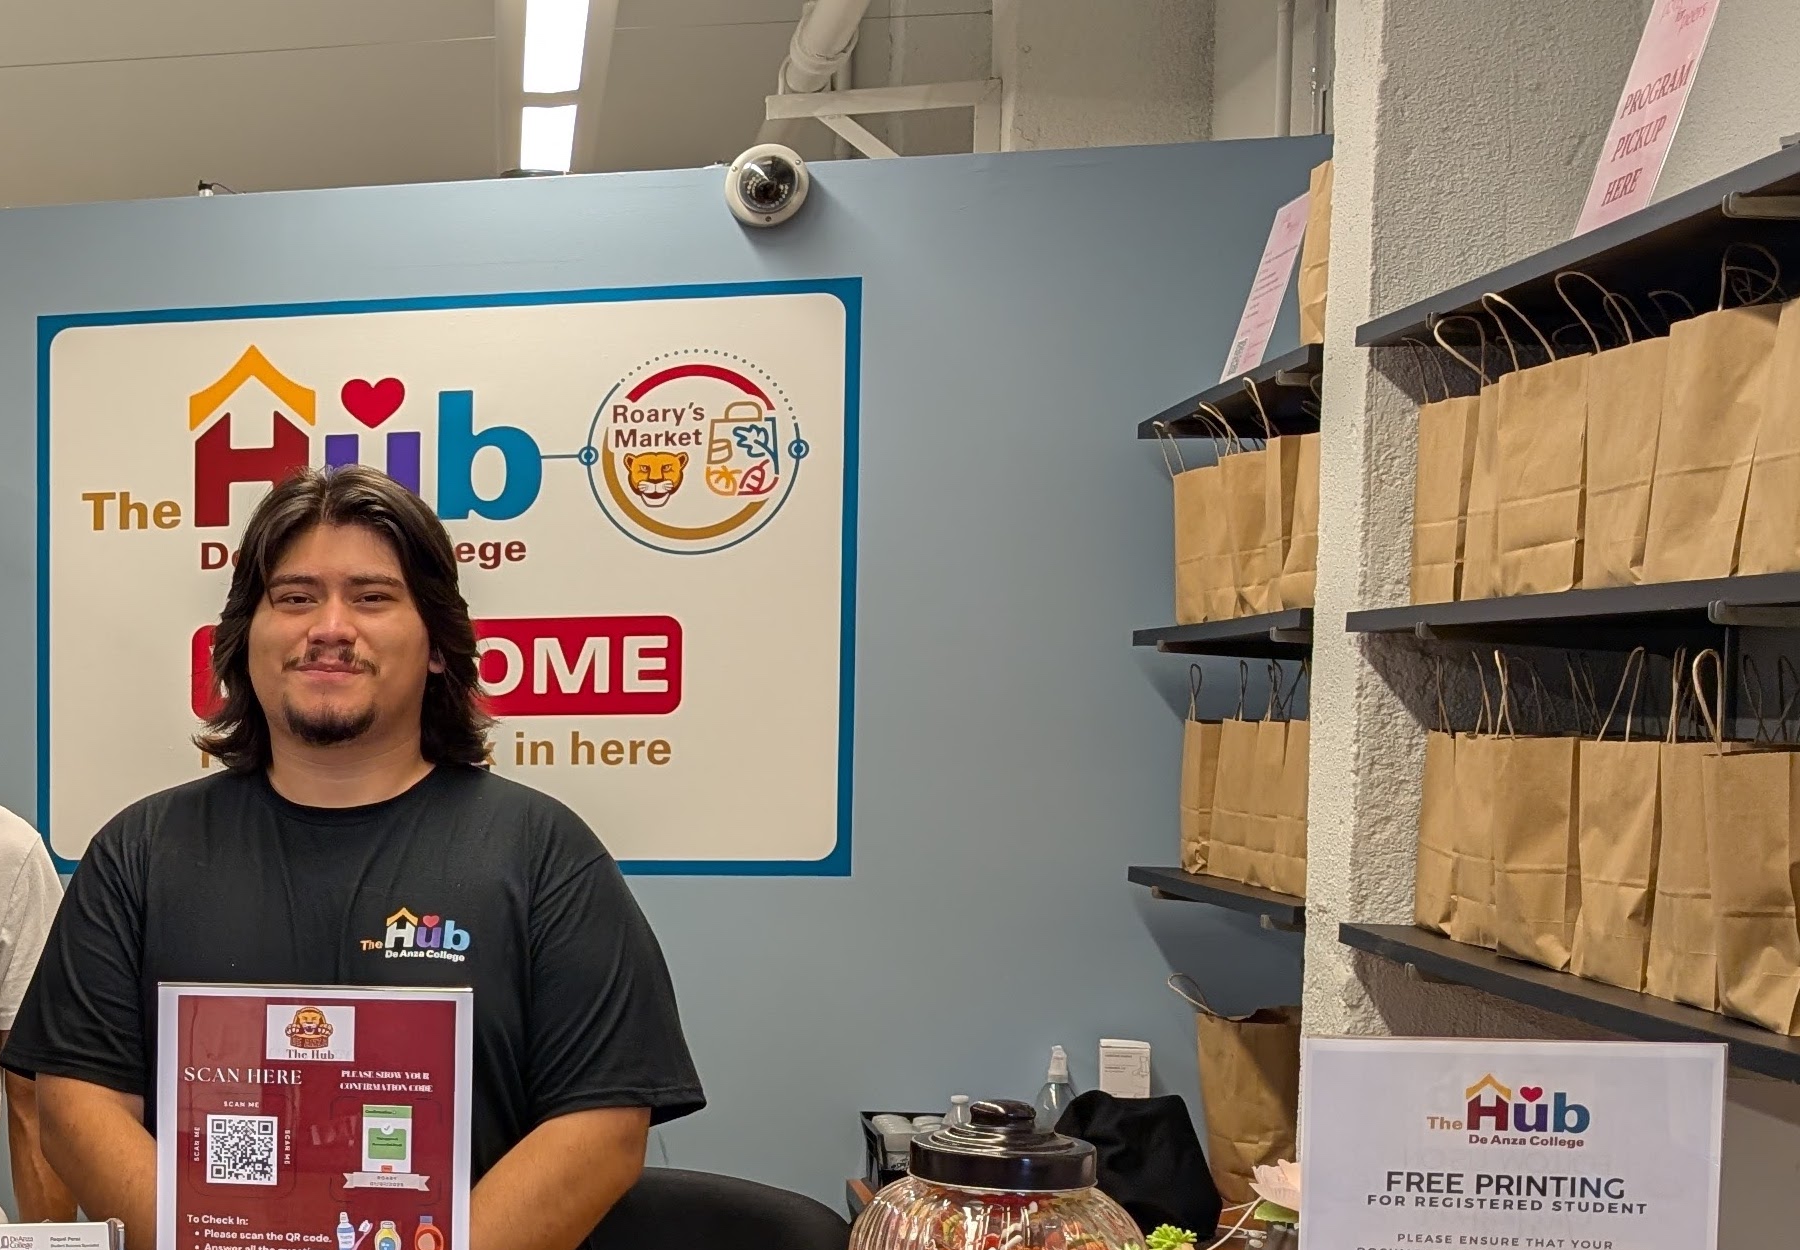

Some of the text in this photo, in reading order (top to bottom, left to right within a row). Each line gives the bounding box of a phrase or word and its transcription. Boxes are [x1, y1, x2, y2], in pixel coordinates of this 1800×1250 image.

[1620, 59, 1695, 119] PROGRAM
[1611, 115, 1667, 162] PICKUP
[1601, 168, 1643, 207] HERE
[613, 402, 704, 427] Roary's
[615, 428, 703, 448] Market
[82, 492, 181, 531] The
[516, 732, 554, 766] in
[571, 731, 671, 766] here
[360, 919, 470, 951] The Hub
[385, 950, 465, 962] De Anza College
[287, 1049, 334, 1060] The Hub
[184, 1067, 302, 1085] SCAN HERE
[341, 1070, 429, 1080] PLEASE SHOW YOUR
[340, 1082, 433, 1093] CONFIRMATION CODE
[1426, 1092, 1591, 1133] The Hub
[1469, 1134, 1584, 1149] De Anza College
[1386, 1171, 1625, 1199] FREE PRINTING
[1367, 1195, 1647, 1214] FOR REGISTERED STUDENT
[187, 1214, 249, 1226] To Check In:
[204, 1229, 237, 1239] Please
[266, 1232, 283, 1240] the
[286, 1233, 301, 1242] QR
[303, 1234, 332, 1243] code.
[1398, 1234, 1613, 1250] PLEASE ENSURE THAT YOUR
